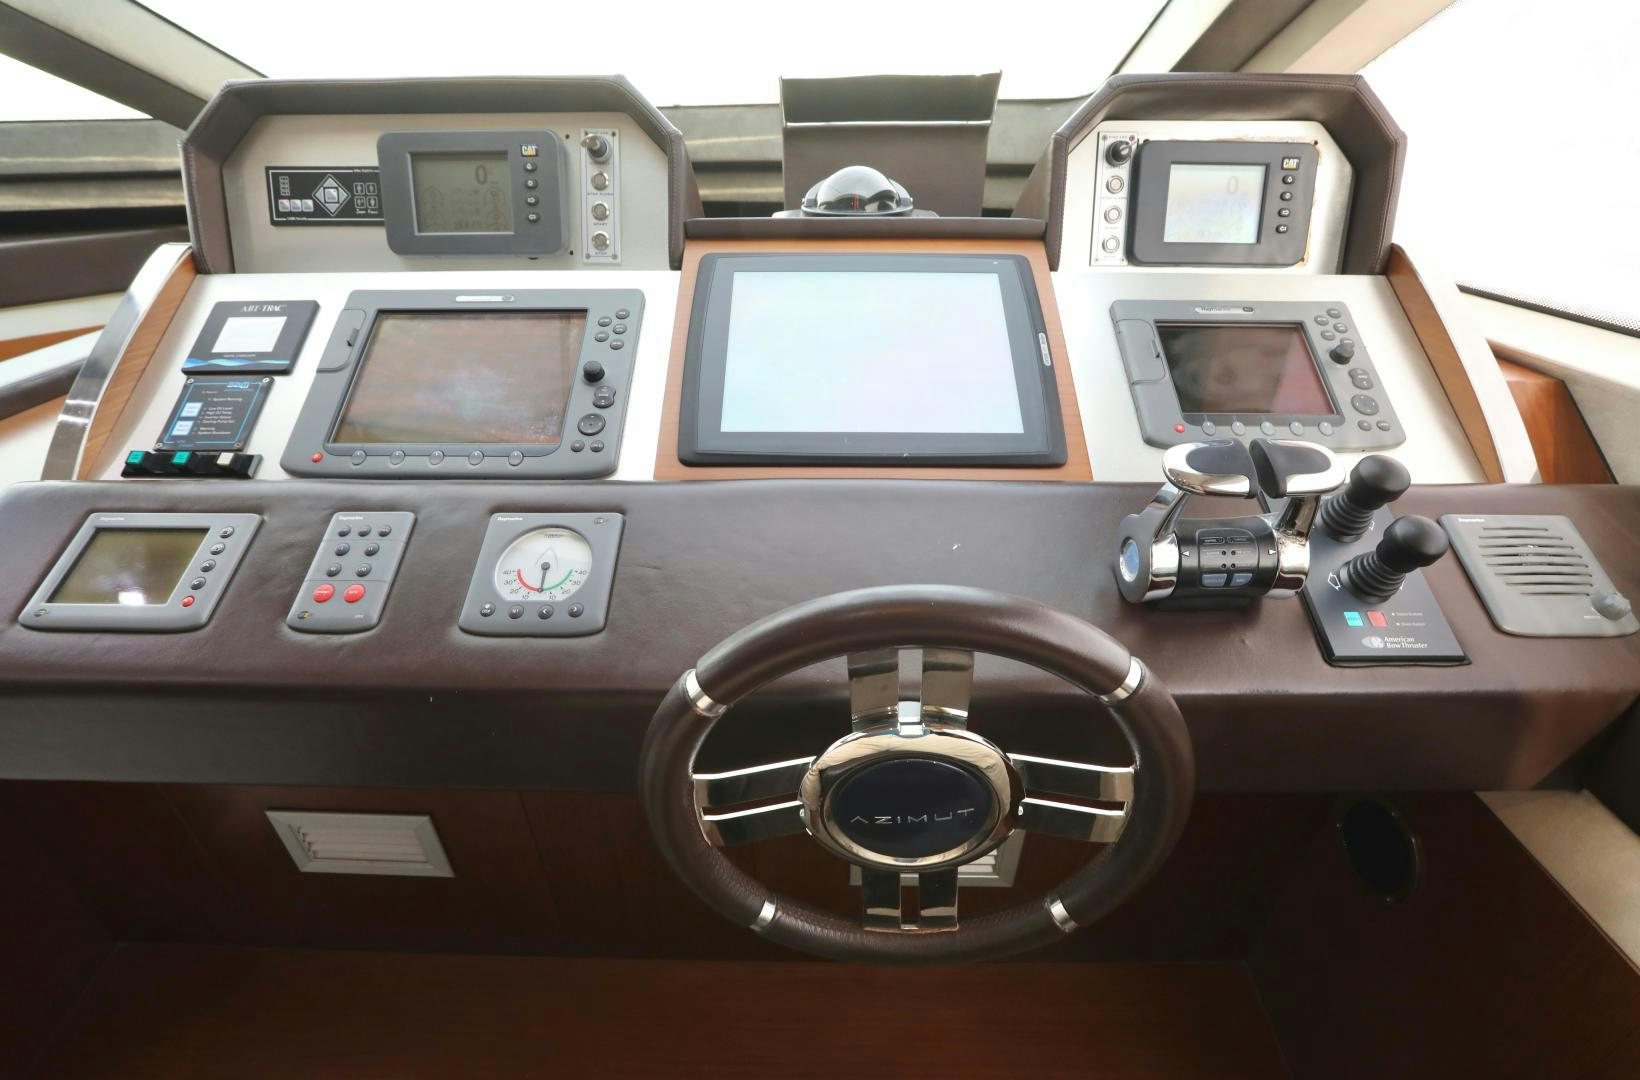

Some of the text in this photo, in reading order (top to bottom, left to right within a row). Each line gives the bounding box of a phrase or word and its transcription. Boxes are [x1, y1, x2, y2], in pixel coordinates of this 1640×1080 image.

[521, 145, 537, 156] CAT
[1283, 158, 1300, 169] CAT
[475, 164, 488, 185] 0
[850, 807, 975, 824] AZIMUT
